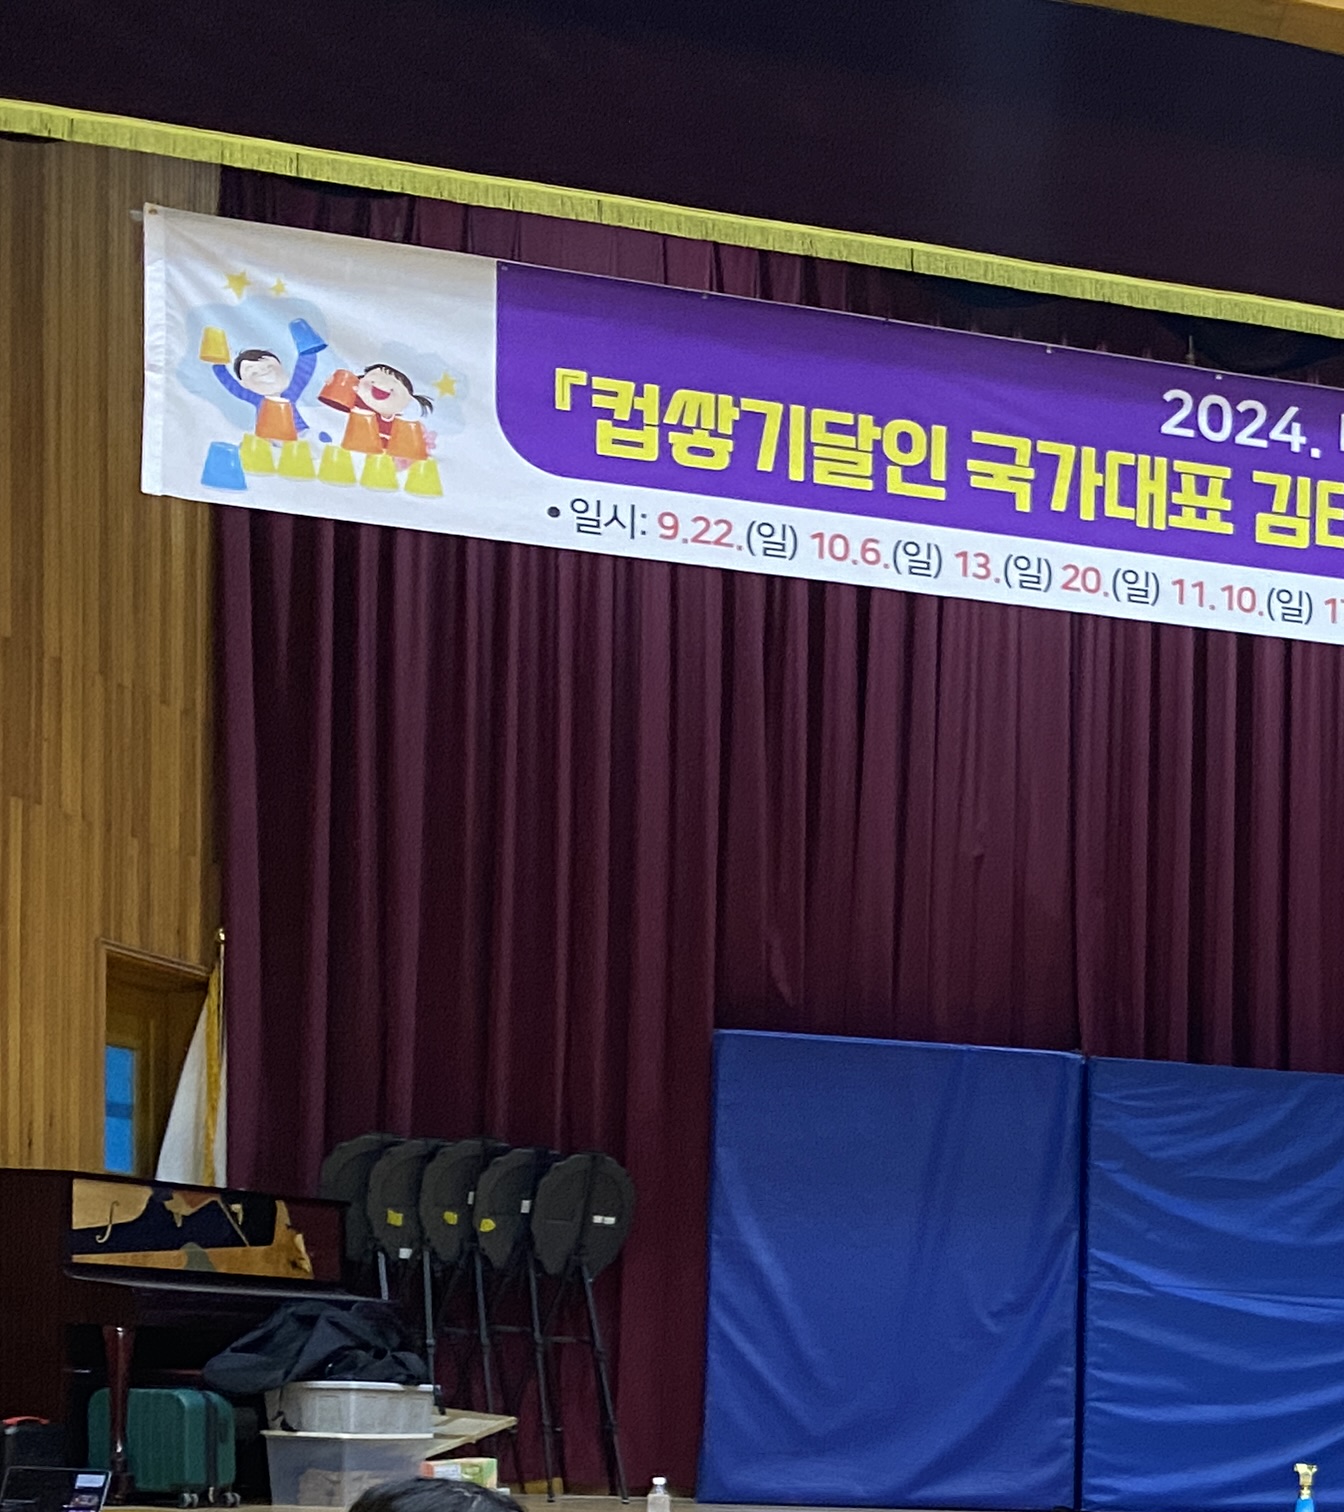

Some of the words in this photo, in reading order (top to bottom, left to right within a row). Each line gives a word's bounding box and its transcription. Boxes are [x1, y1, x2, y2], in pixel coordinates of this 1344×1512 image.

[1160, 388, 1322, 459] 2024.
[967, 431, 1233, 534] 국가대표
[569, 497, 649, 541] 일시:
[657, 511, 799, 562] 9.22.(일)
[809, 531, 944, 580] 10.6.(일)
[953, 550, 1054, 594] 13.(일)
[1060, 563, 1161, 608] 20.(일)
[1171, 578, 1314, 626] 11.10.(일)
